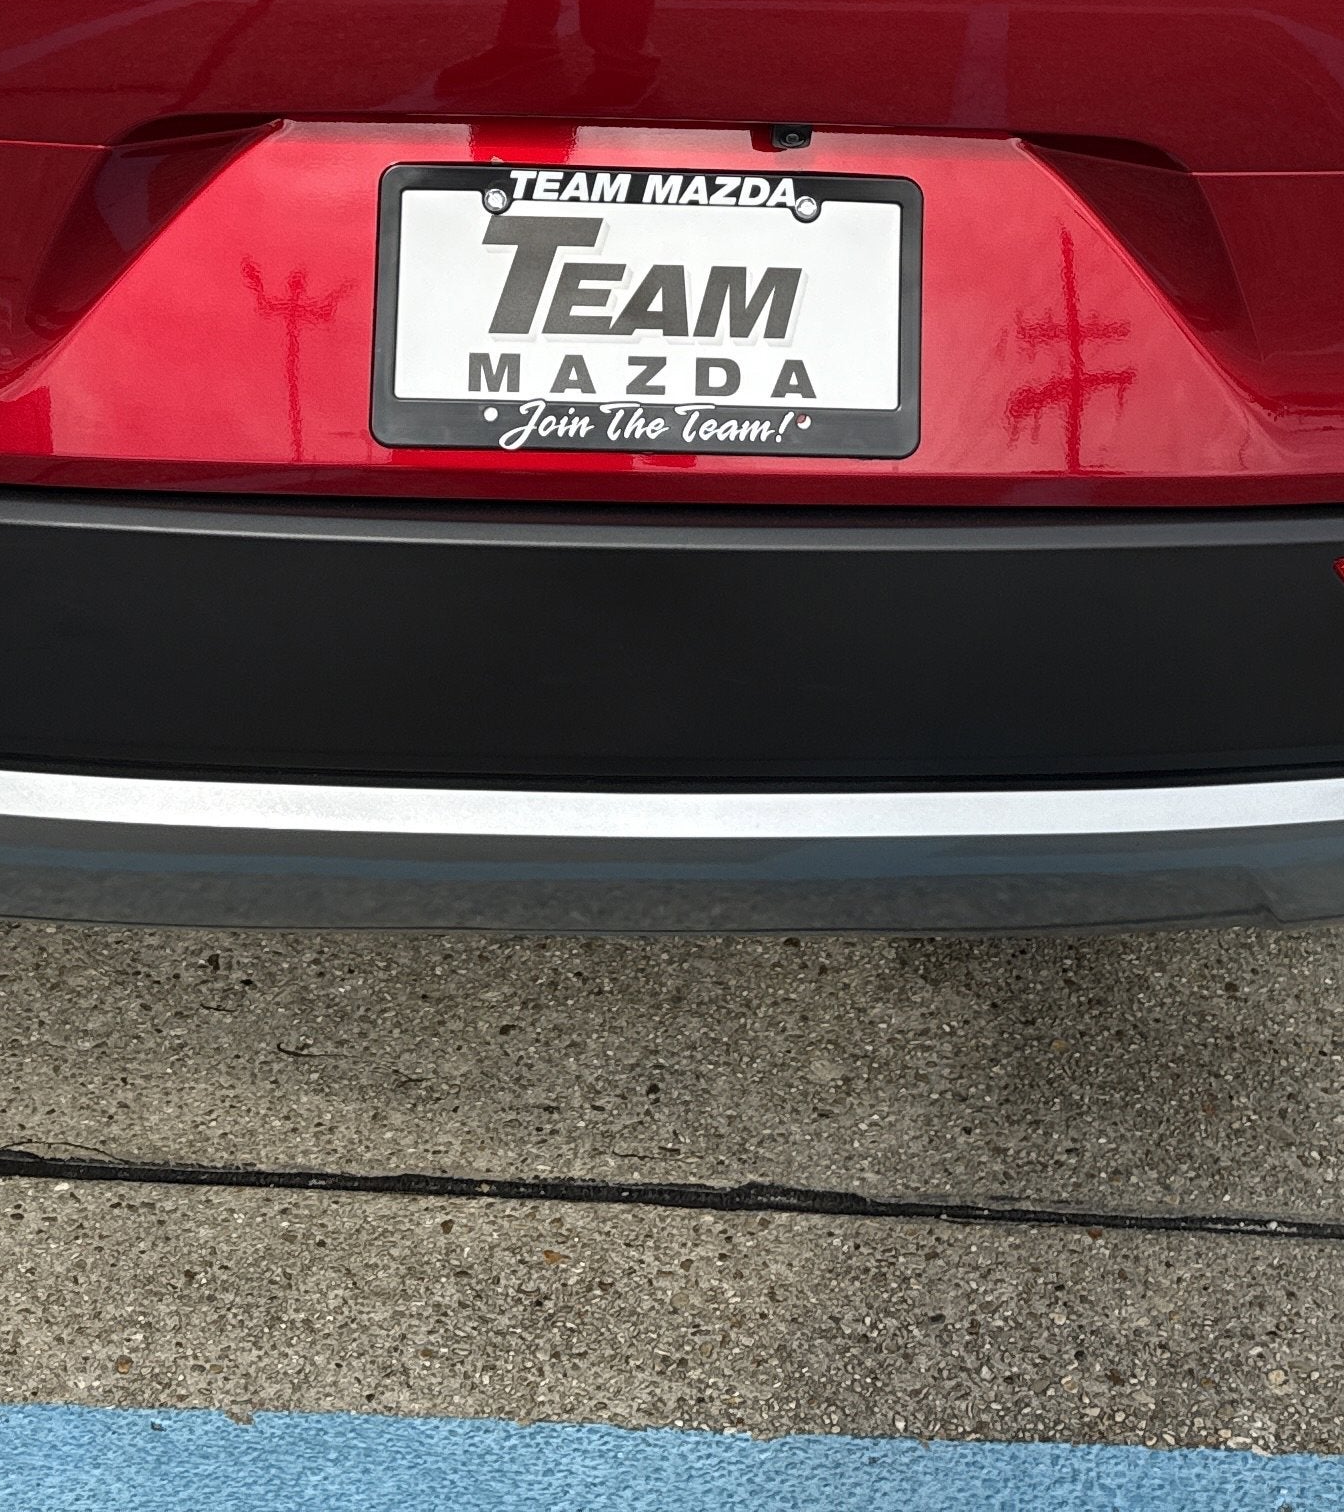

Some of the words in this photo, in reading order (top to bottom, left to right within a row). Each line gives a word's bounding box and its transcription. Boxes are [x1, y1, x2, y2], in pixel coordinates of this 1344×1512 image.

[509, 170, 632, 203] TEAM
[642, 174, 797, 207] MAZDA
[482, 216, 804, 341] TEAM
[467, 352, 817, 399] MAZDA
[499, 398, 594, 449] Join
[600, 401, 670, 441] The
[674, 404, 795, 443] Team!
